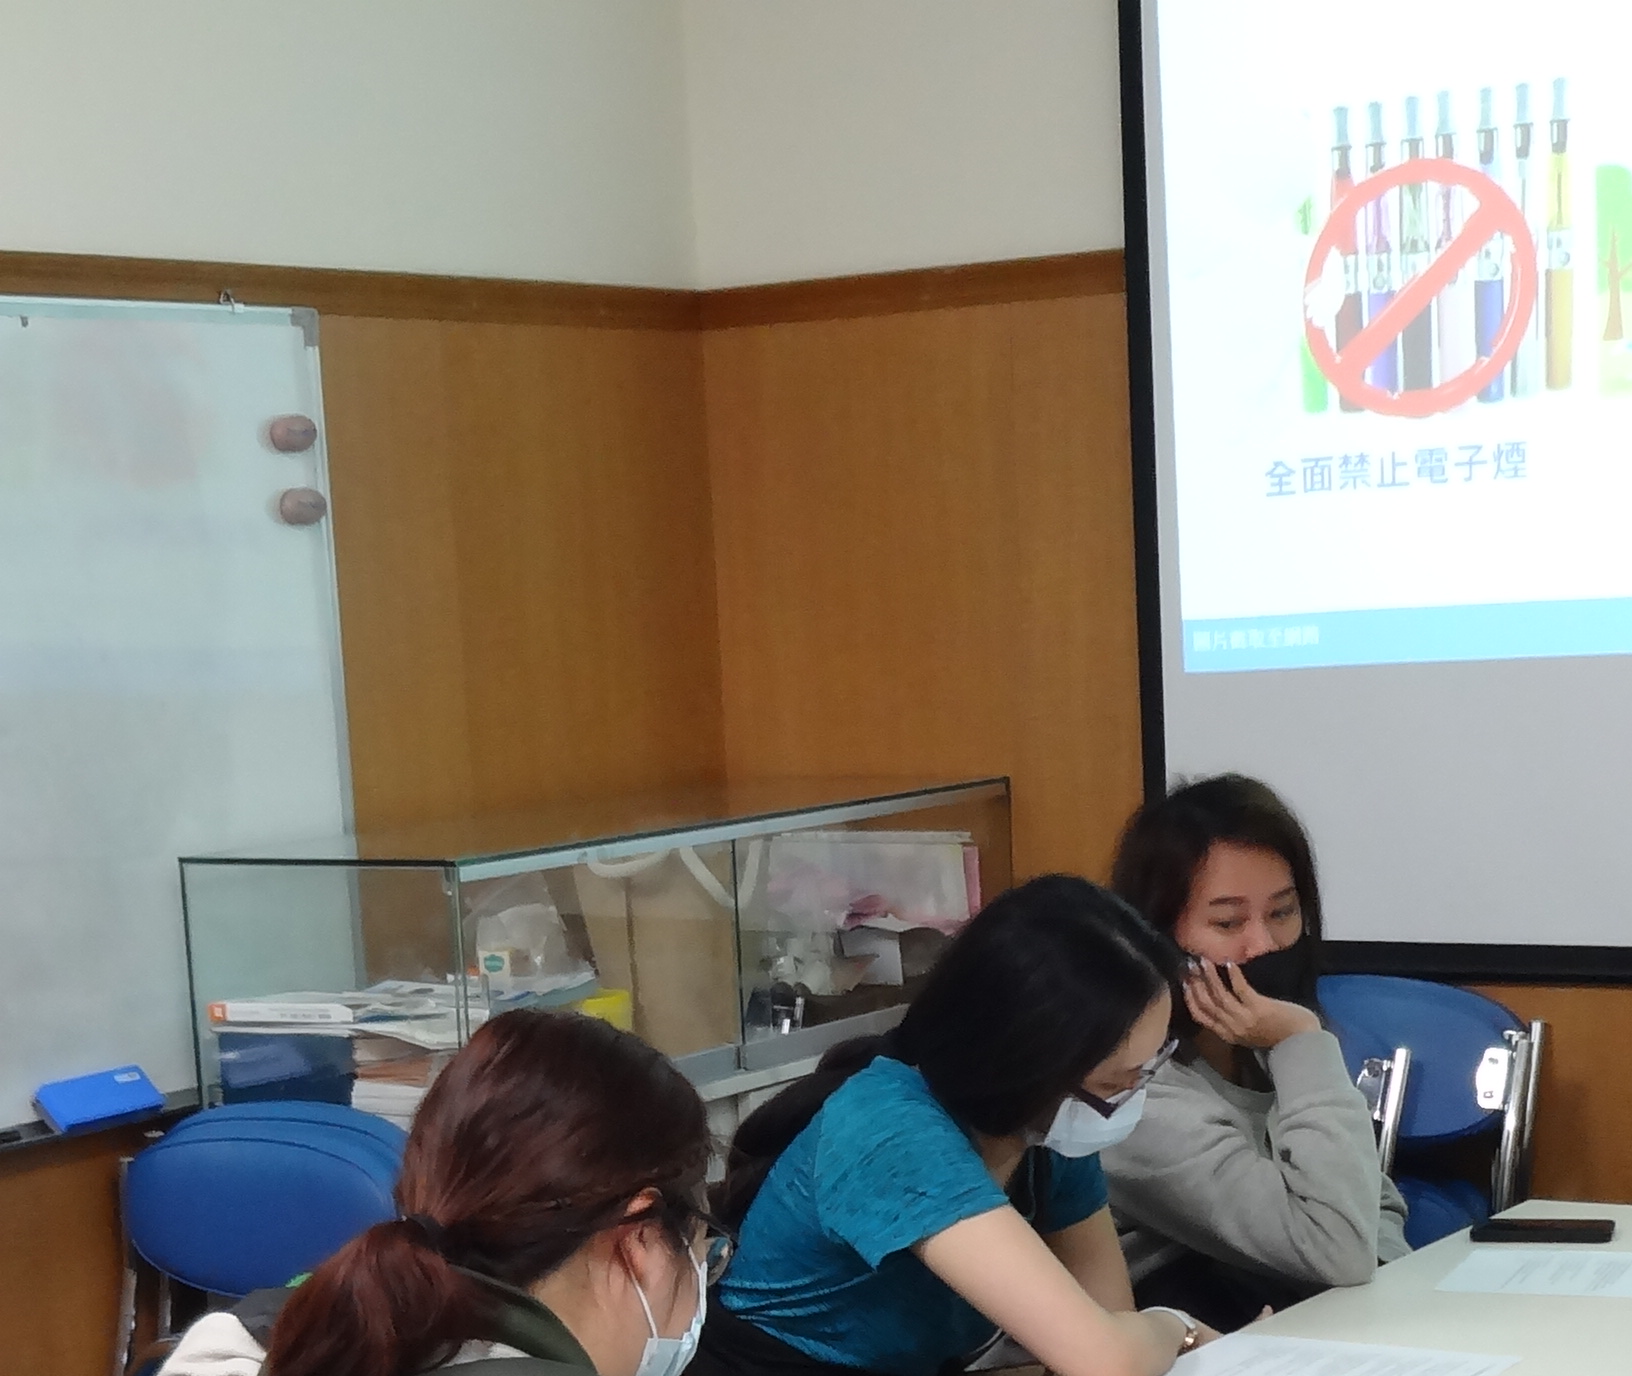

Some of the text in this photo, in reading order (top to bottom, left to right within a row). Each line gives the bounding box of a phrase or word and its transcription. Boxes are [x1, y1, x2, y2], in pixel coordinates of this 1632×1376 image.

[1265, 441, 1527, 497] 全面禁止電子煙
